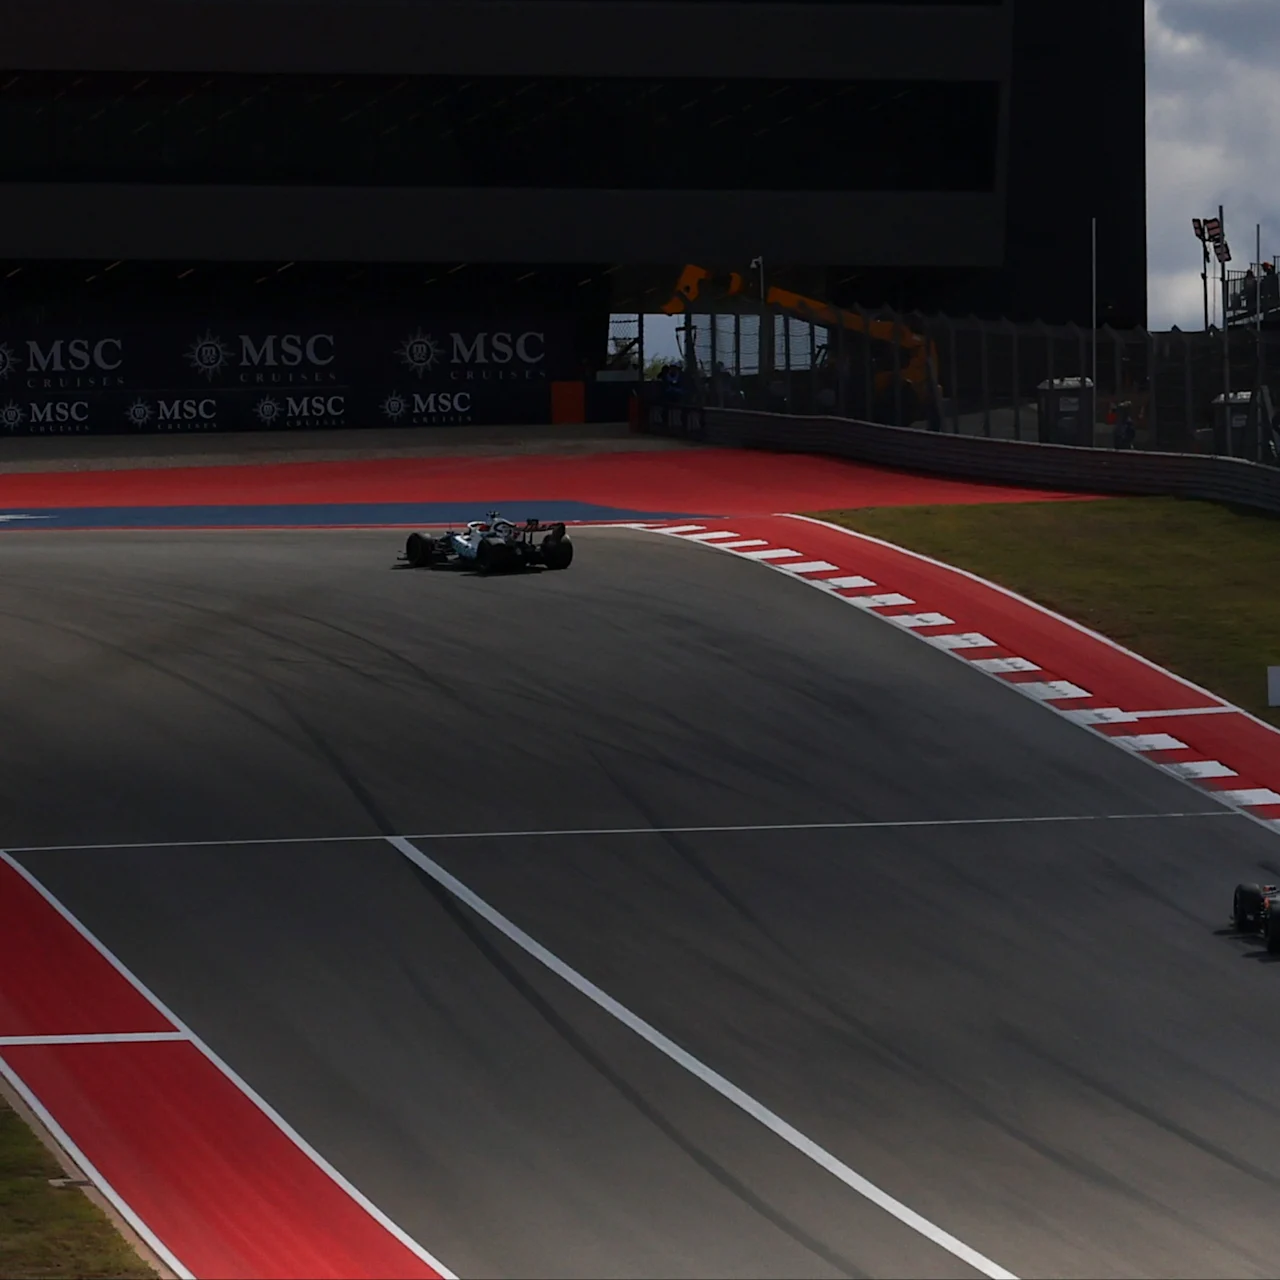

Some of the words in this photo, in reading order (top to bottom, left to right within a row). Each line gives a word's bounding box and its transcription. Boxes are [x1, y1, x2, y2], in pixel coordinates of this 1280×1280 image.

[26, 338, 123, 371] MSC
[238, 334, 335, 367] MSC
[449, 331, 545, 364] MSC
[26, 376, 125, 389] CRUISES
[239, 372, 337, 383] CRUISES
[450, 370, 546, 381] CRUISES
[29, 401, 89, 423] MSC
[157, 399, 217, 420] MSC
[286, 396, 345, 417] MSC
[412, 392, 471, 413] MSC
